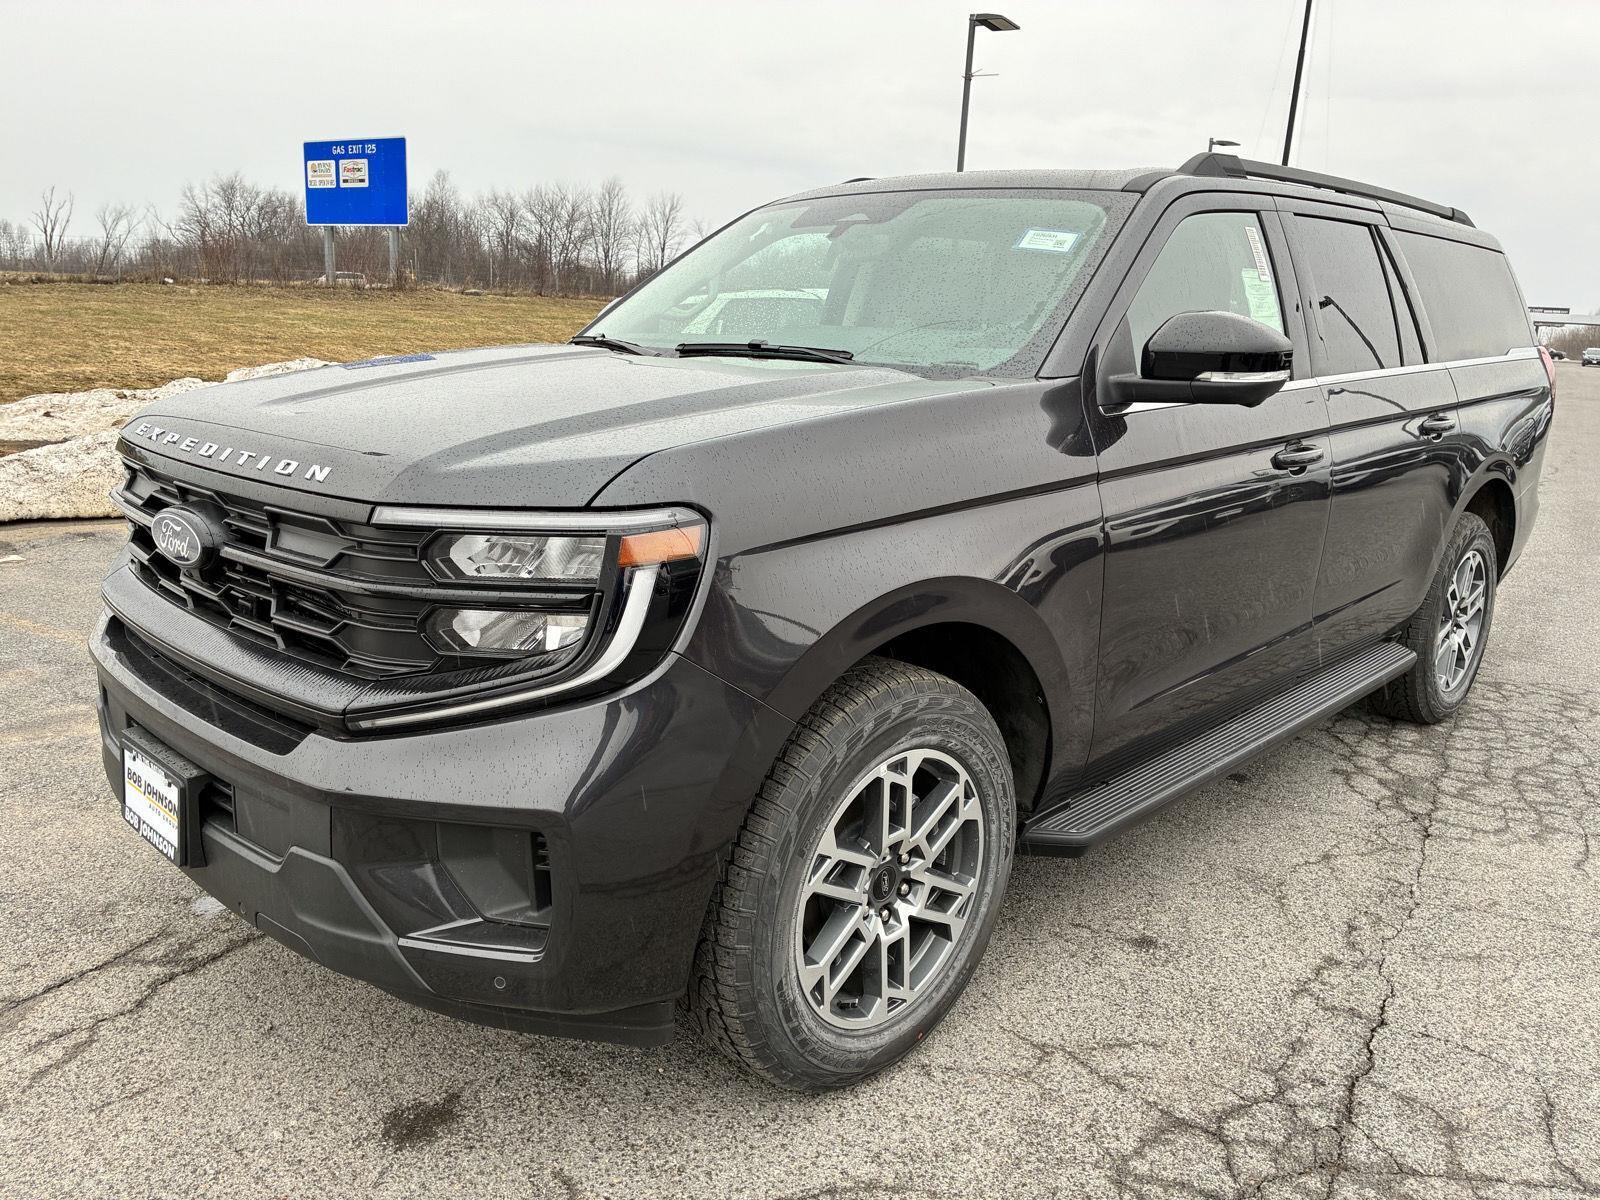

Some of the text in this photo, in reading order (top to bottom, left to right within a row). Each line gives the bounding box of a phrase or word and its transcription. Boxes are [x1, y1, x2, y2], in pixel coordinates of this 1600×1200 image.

[332, 144, 377, 155] GAS EXIT 125
[343, 165, 363, 173] Fastrac
[135, 422, 332, 483] EXPEDITION
[159, 519, 190, 559] Ford
[127, 766, 178, 817] BOB JOHNSON
[124, 805, 175, 861] BOB JOHNSON
